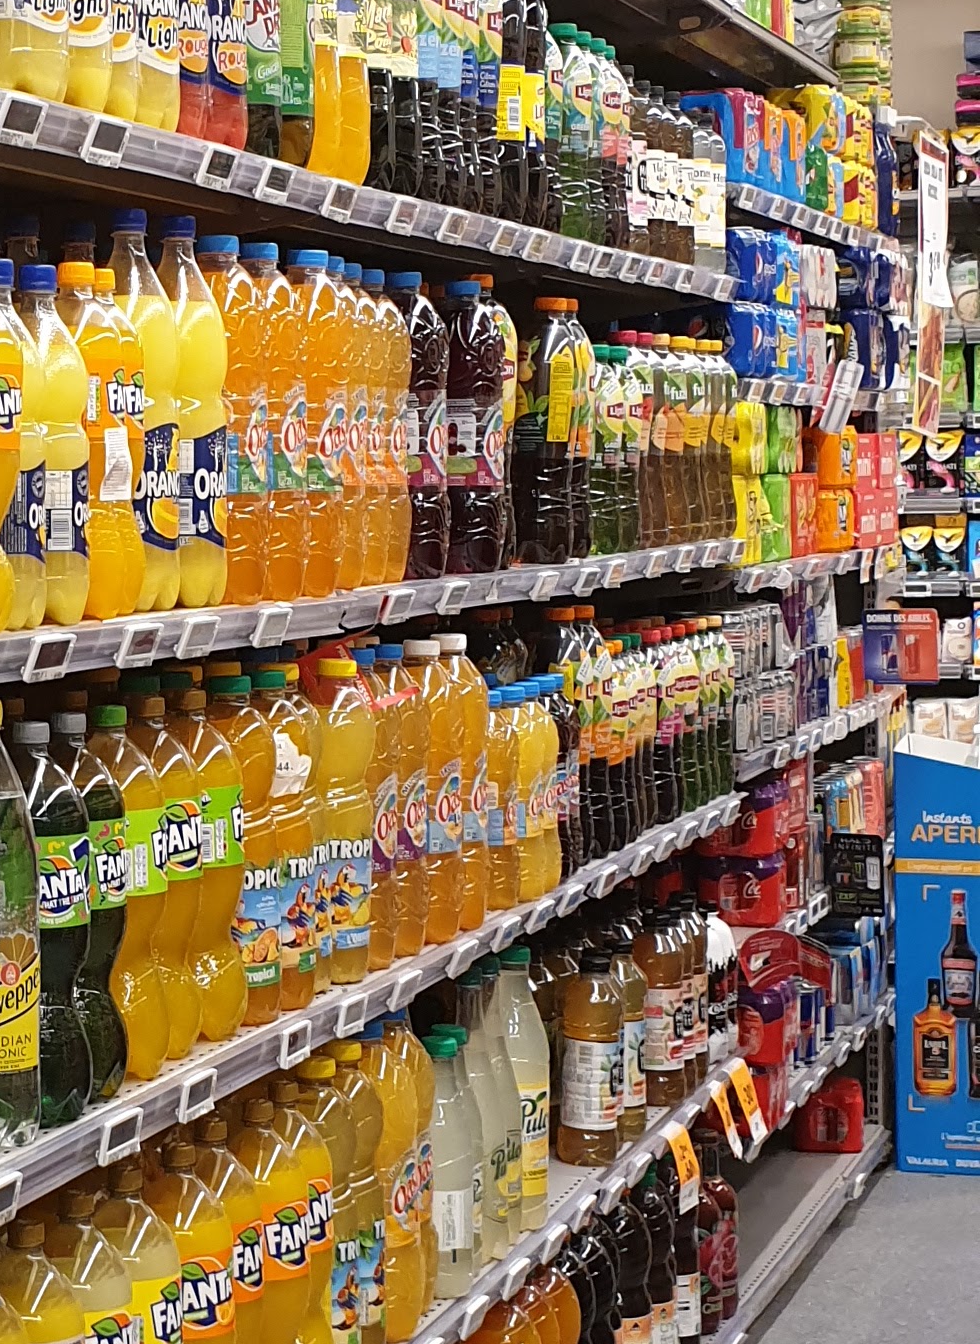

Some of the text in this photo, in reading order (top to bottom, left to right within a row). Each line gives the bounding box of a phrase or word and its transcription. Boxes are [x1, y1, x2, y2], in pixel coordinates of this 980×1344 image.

[922, 810, 973, 825] Instants
[40, 866, 86, 901] ANTA
[247, 966, 276, 983] ropical
[183, 1270, 232, 1311] ANTA
